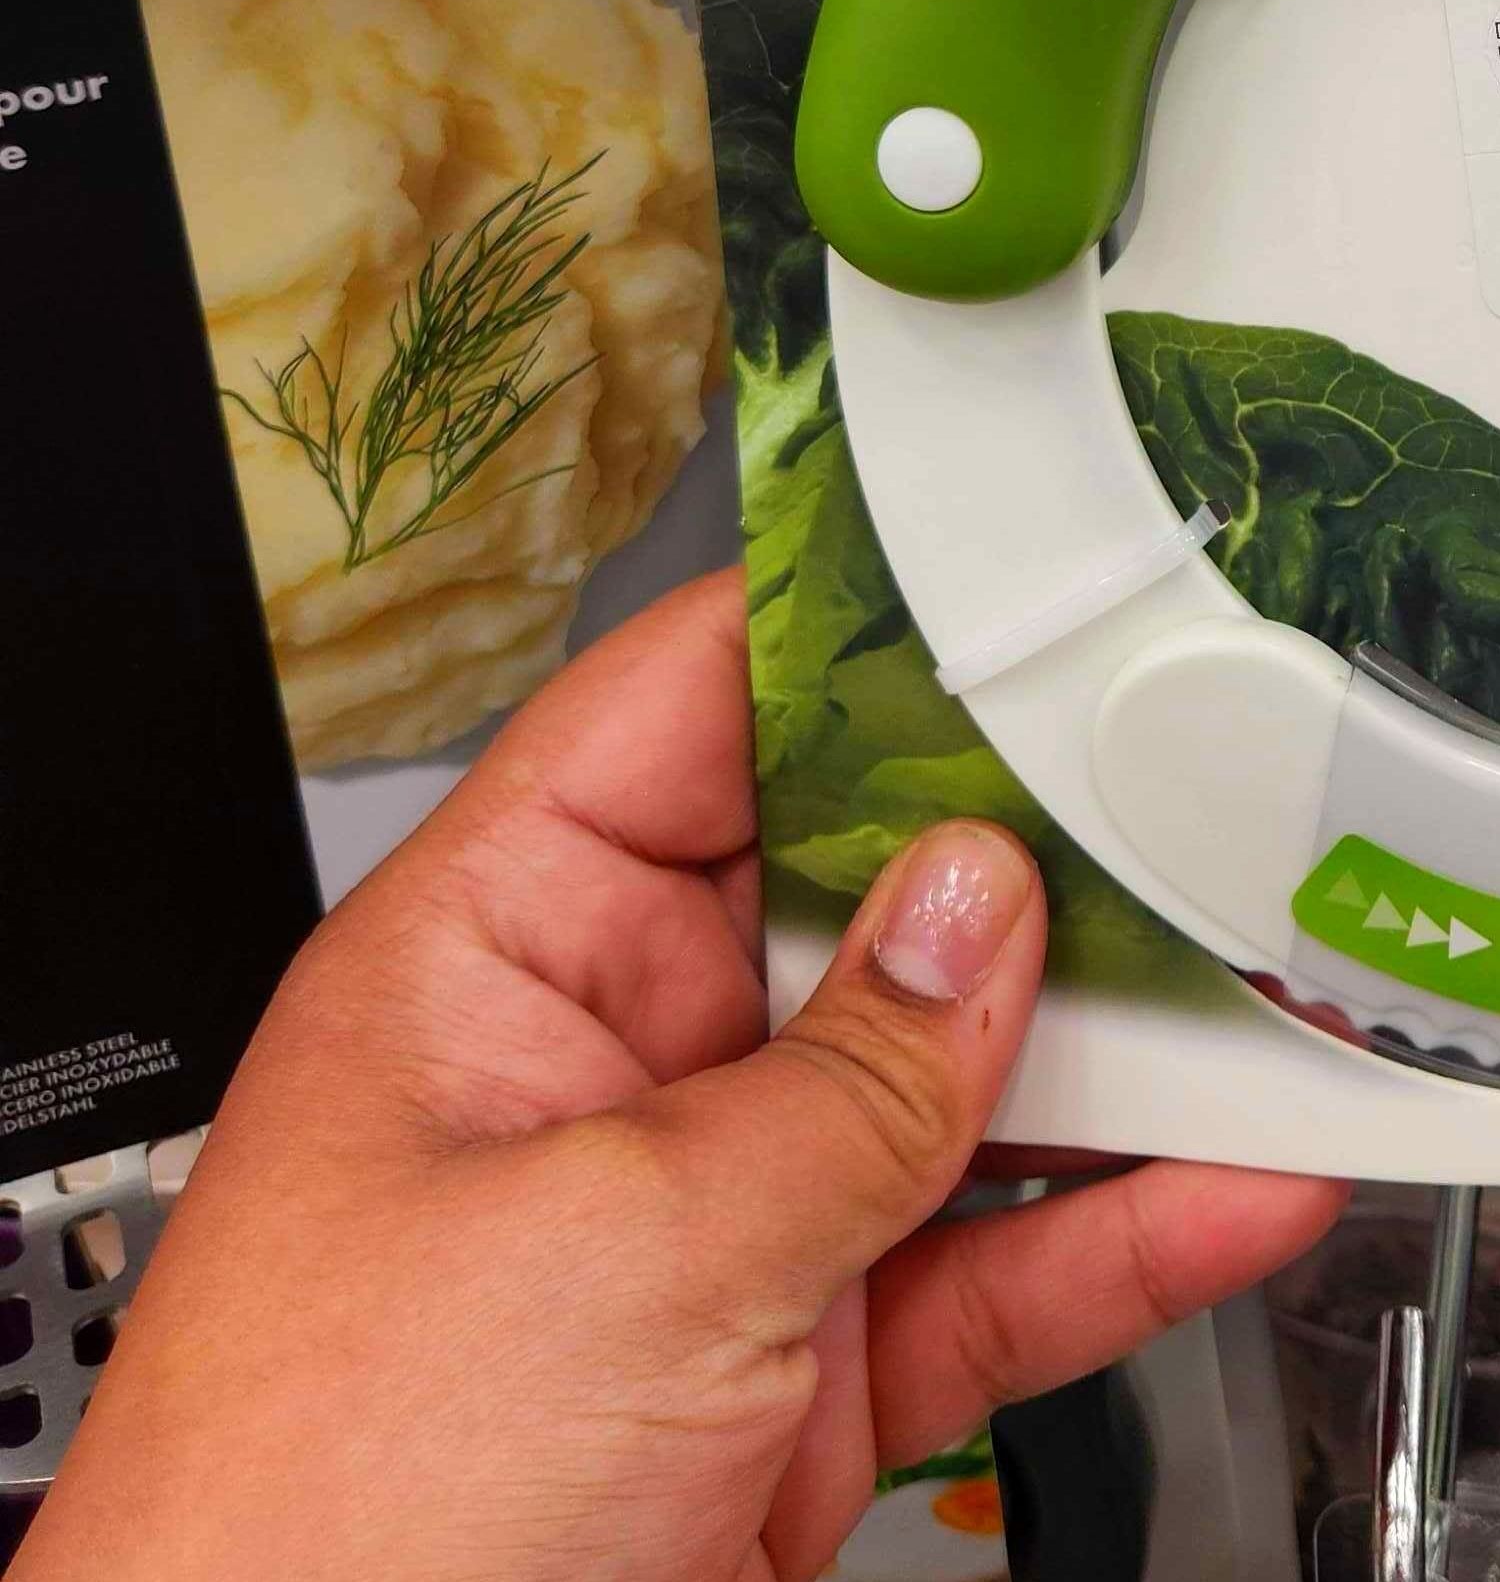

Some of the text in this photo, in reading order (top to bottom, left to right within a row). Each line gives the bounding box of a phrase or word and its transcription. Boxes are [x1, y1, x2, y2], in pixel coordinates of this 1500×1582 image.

[45, 1038, 173, 1085] INOXYDABLE
[86, 1032, 138, 1056] STEEL
[0, 1053, 181, 1116] CERO INOXIDABLE
[0, 1095, 98, 1135] DELSTAHL
